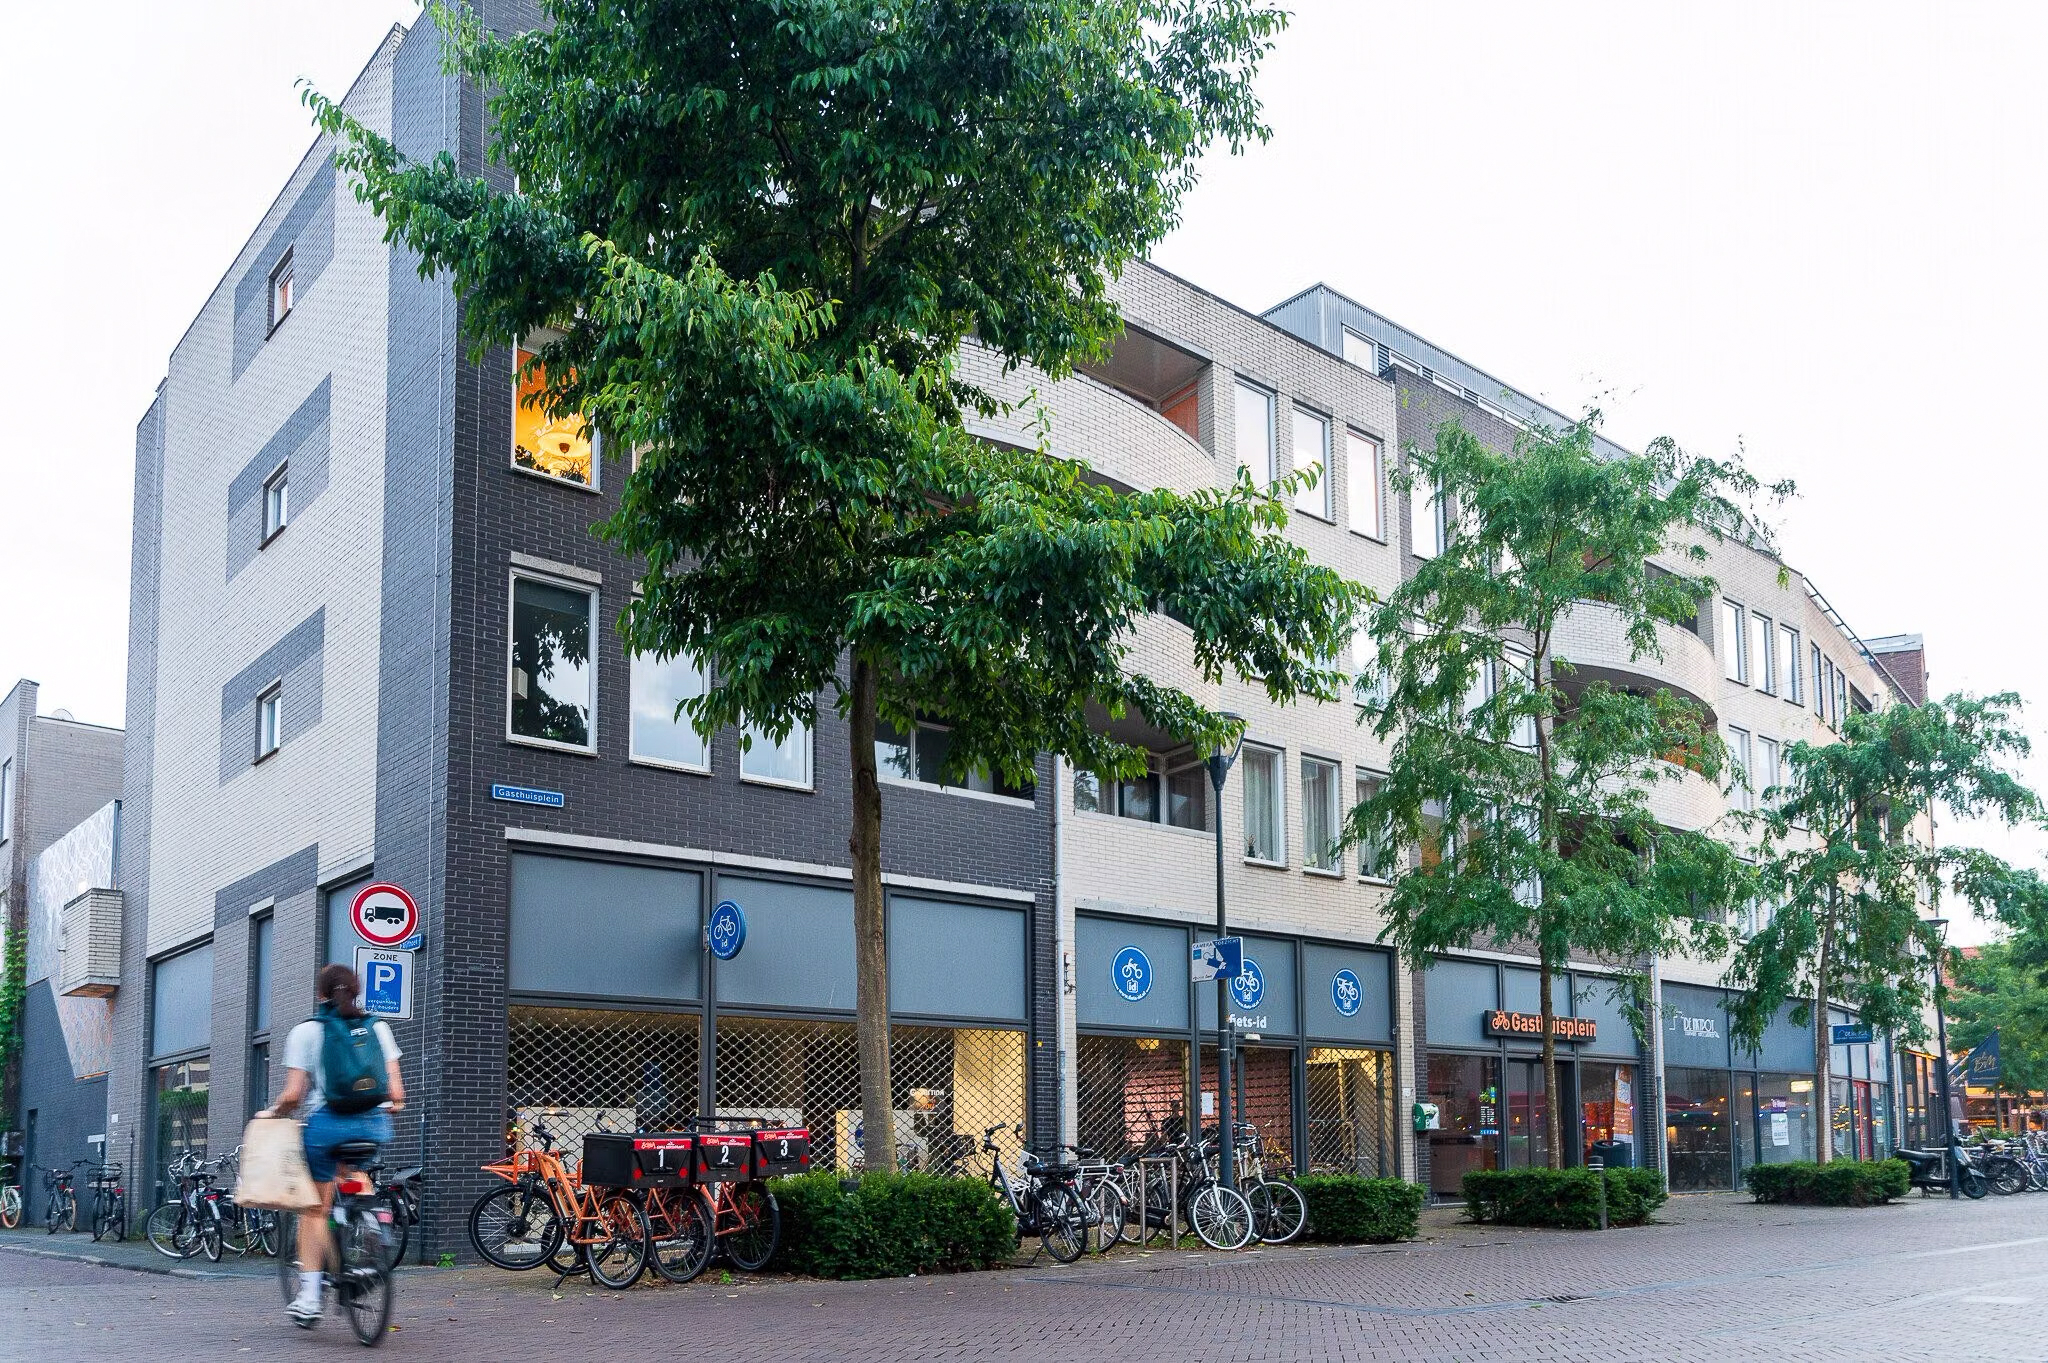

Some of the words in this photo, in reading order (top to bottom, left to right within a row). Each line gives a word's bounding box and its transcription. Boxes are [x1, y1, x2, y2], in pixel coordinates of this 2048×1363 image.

[498, 788, 559, 803] Gasthuisplein
[373, 952, 398, 962] ZONE
[374, 964, 396, 992] P
[1128, 980, 1137, 991] id
[721, 1145, 729, 1163] 2
[780, 1140, 788, 1156] 3
[658, 1149, 664, 1168] 1
